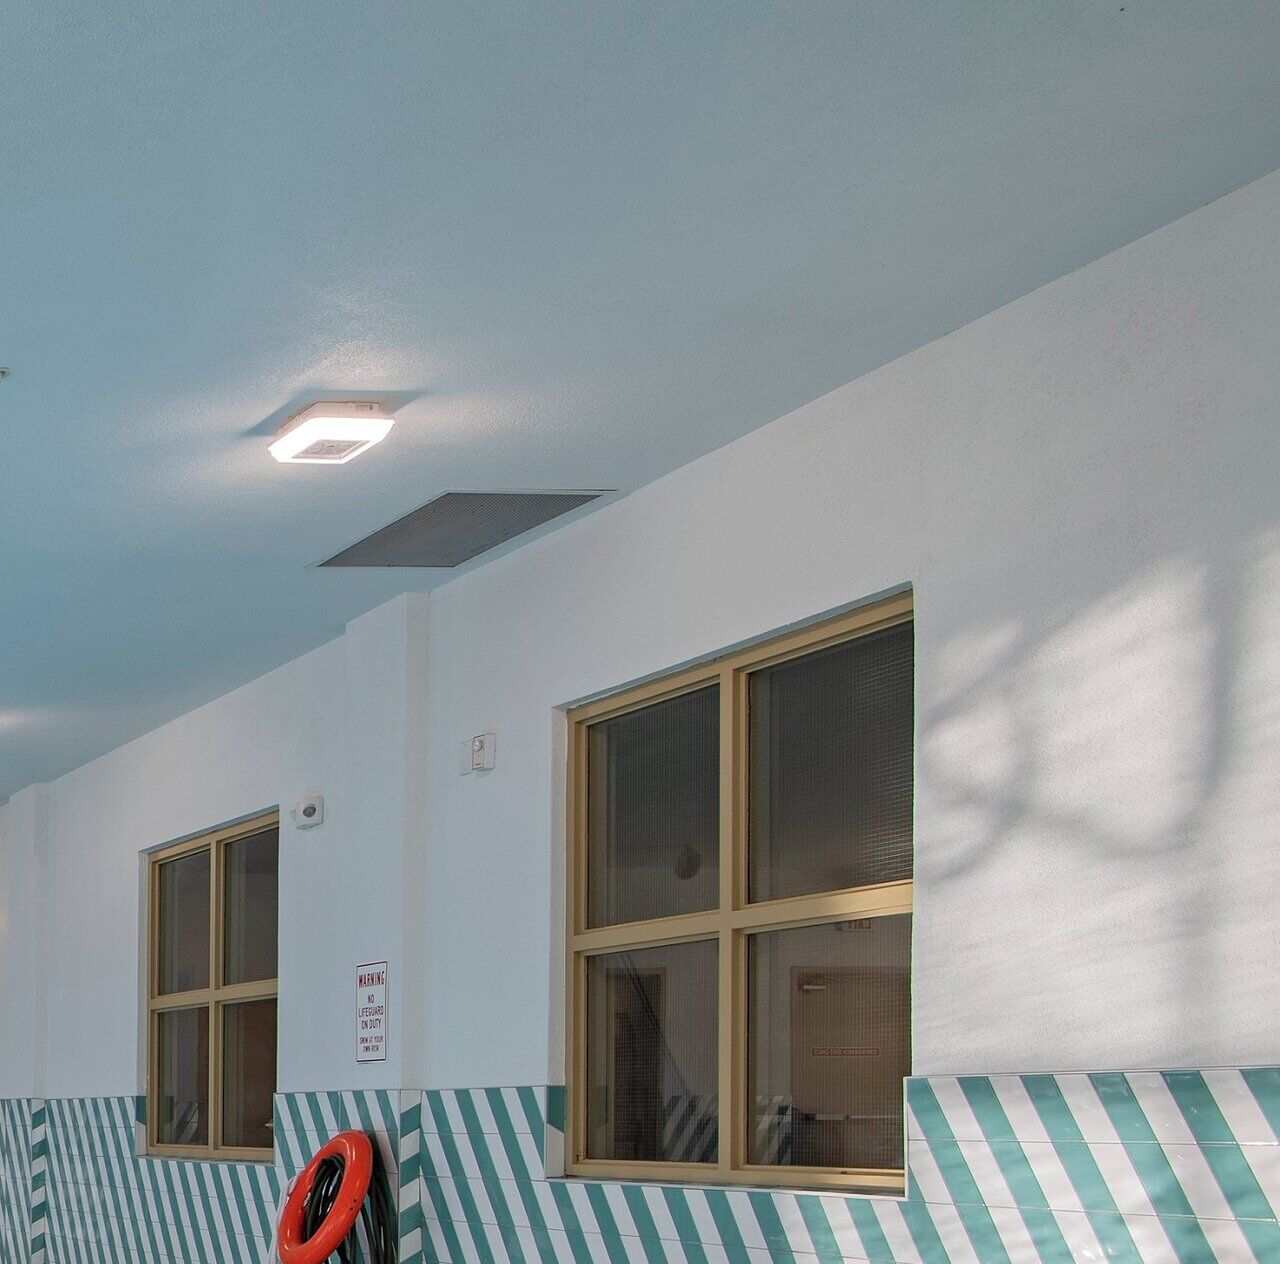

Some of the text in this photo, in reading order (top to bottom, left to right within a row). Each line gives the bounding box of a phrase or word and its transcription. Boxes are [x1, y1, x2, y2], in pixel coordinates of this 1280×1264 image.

[358, 971, 385, 989] WARNING
[367, 994, 375, 1003] NO
[358, 1005, 384, 1018] LIFEGUARD
[361, 1018, 381, 1029] ON DUTY
